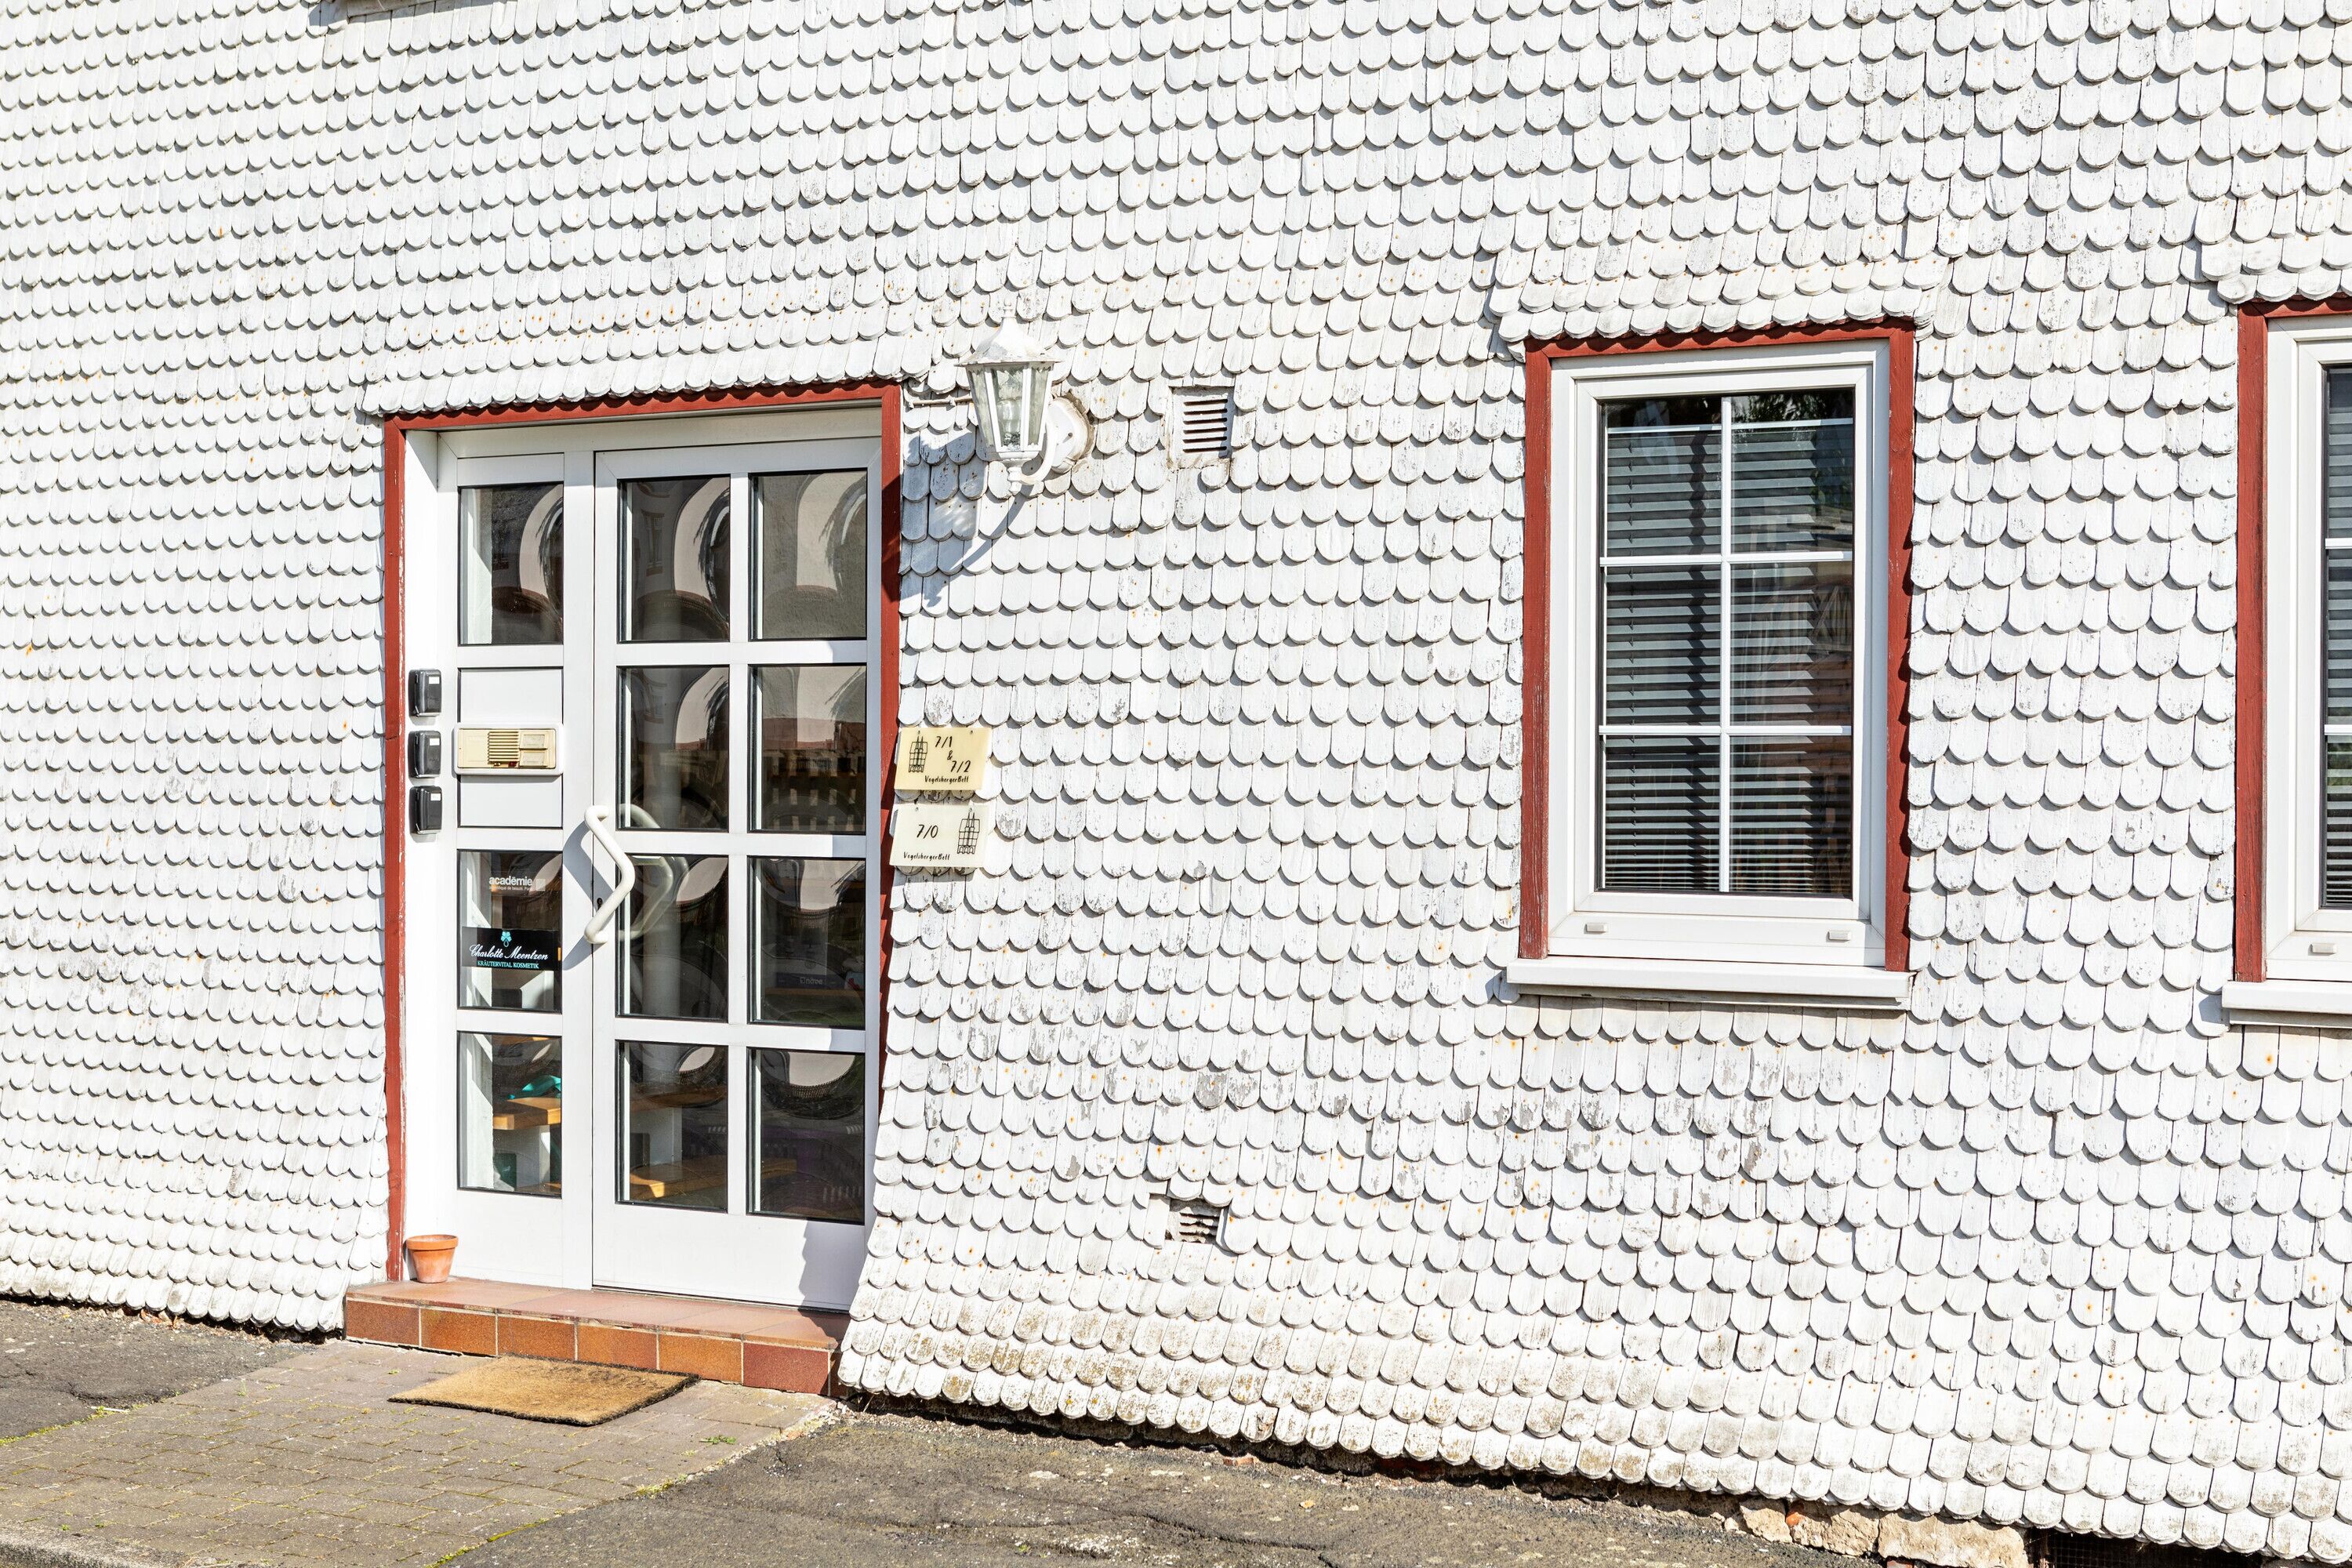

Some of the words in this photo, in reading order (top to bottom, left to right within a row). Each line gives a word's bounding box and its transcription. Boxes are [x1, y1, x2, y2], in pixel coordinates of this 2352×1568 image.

[935, 736, 953, 748] 7/1
[947, 750, 953, 760] &
[951, 760, 971, 773] 7/2
[916, 824, 938, 839] 7/0
[470, 943, 503, 959] Charlotte
[504, 946, 549, 960] Meentzen
